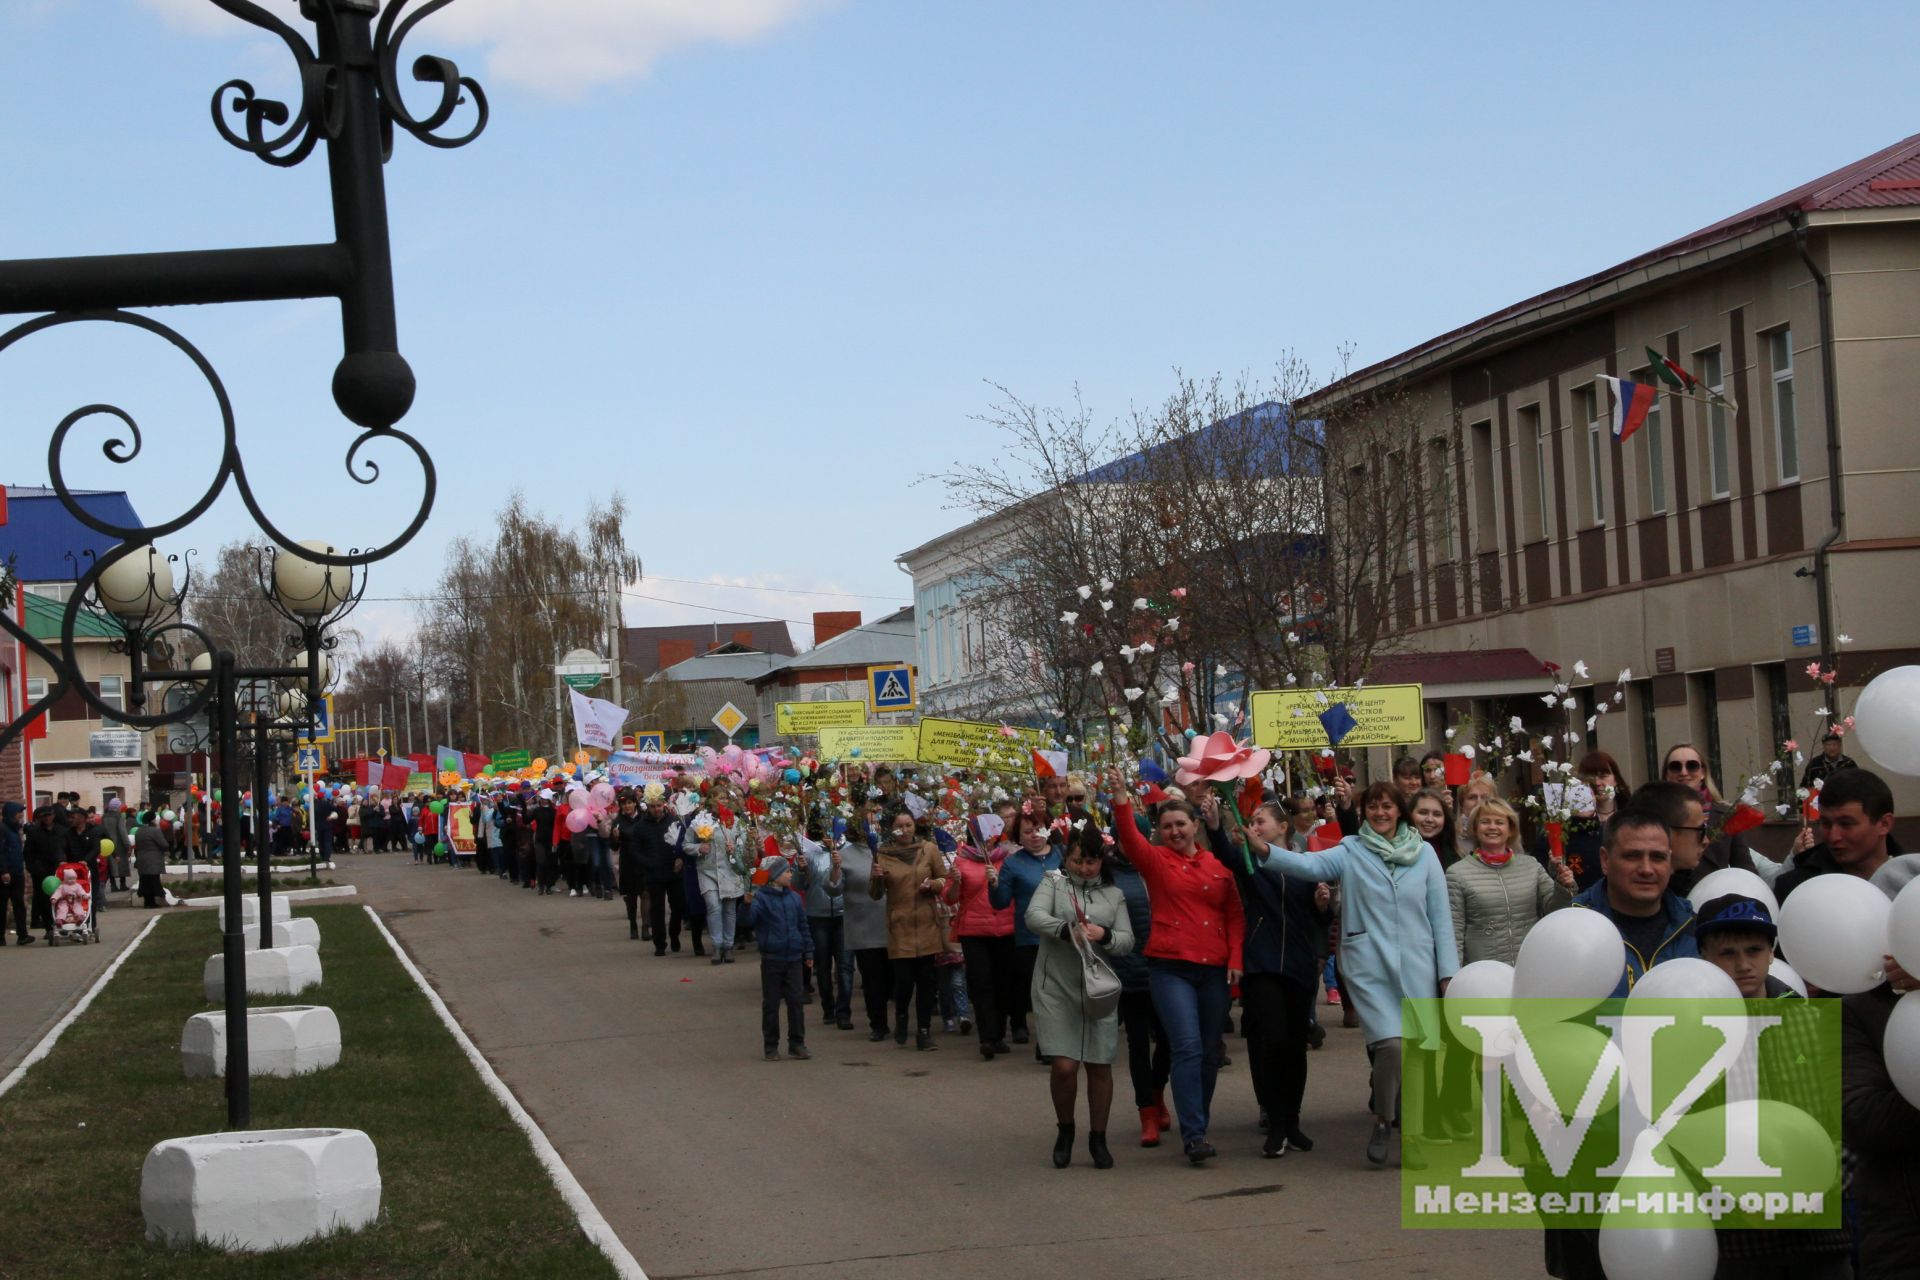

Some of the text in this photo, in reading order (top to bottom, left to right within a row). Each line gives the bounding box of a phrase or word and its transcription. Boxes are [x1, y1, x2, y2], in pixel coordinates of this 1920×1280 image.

[1365, 699, 1386, 707] ЦЕНТР
[975, 727, 998, 735] ГАУСО
[453, 807, 475, 840] 1
